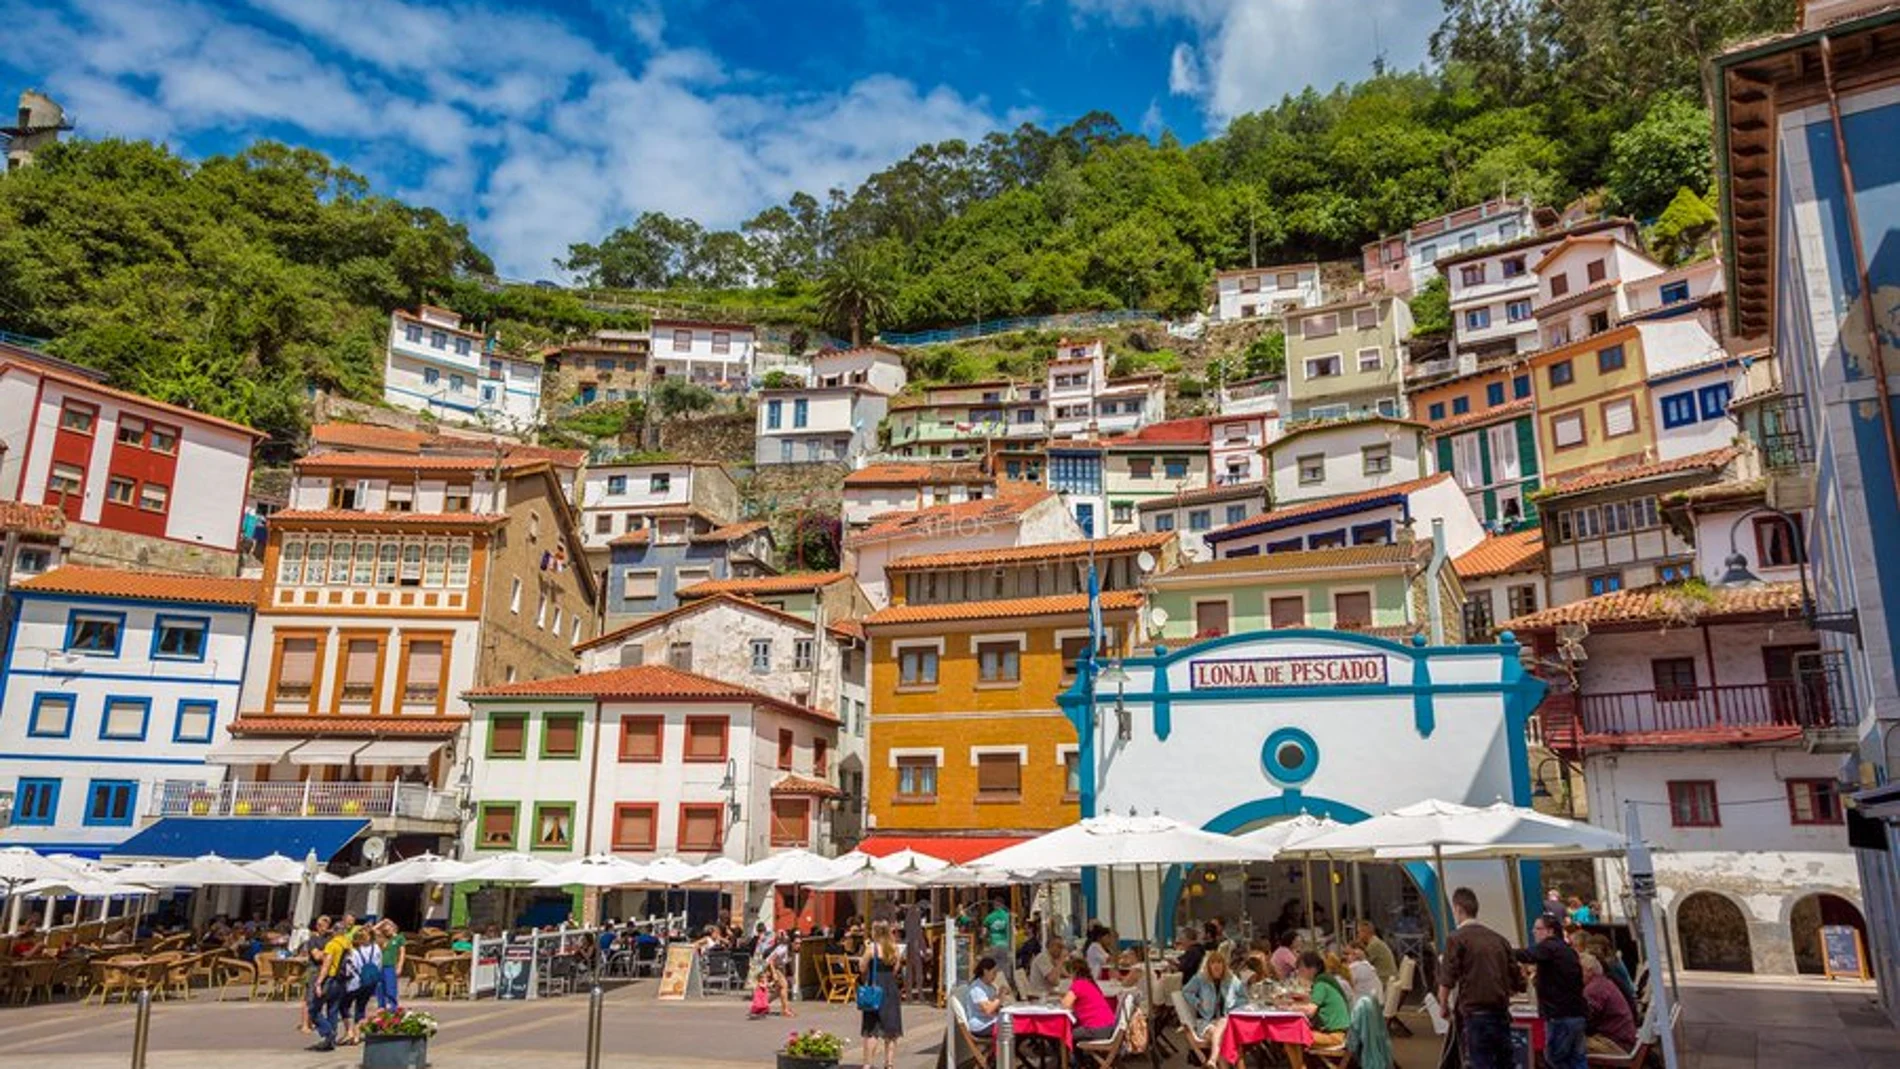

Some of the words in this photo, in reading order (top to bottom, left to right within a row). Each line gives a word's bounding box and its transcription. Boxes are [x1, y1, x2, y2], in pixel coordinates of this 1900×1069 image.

[1198, 664, 1257, 686] LONJA
[1264, 665, 1284, 684] DE
[1291, 659, 1378, 682] PESCADO
